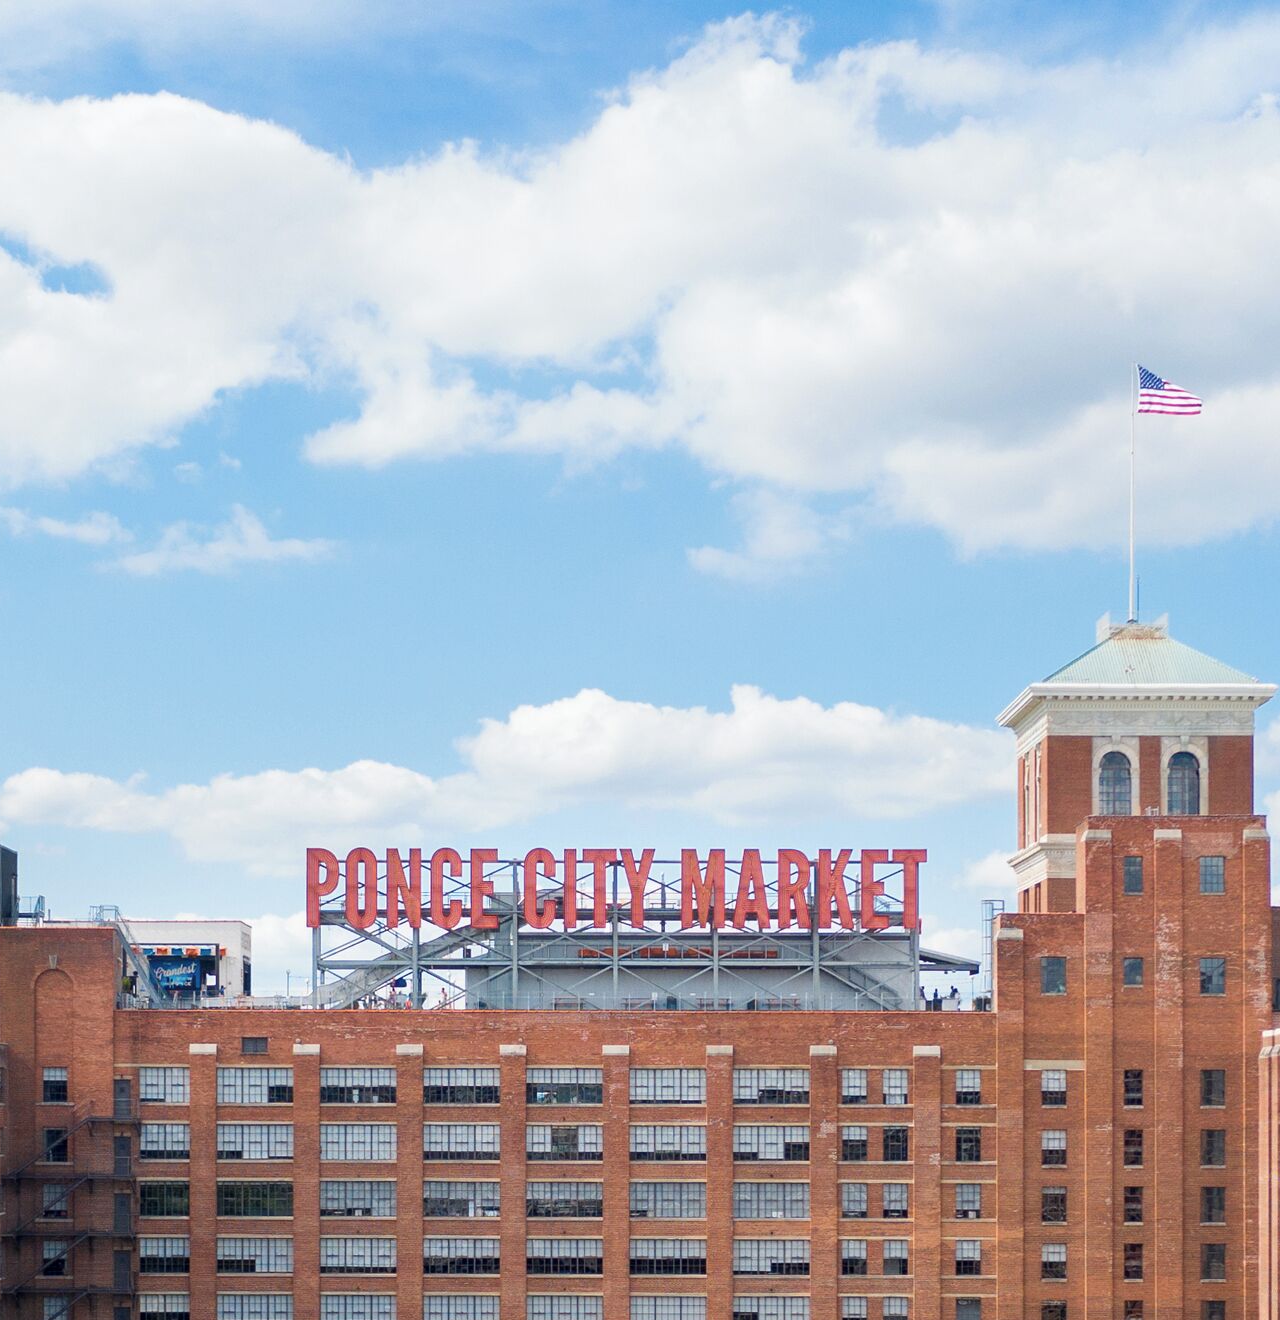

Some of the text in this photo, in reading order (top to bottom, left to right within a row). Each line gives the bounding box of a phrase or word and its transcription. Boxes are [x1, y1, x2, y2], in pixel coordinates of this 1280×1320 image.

[306, 848, 927, 930] PONCE CITY MARKET
